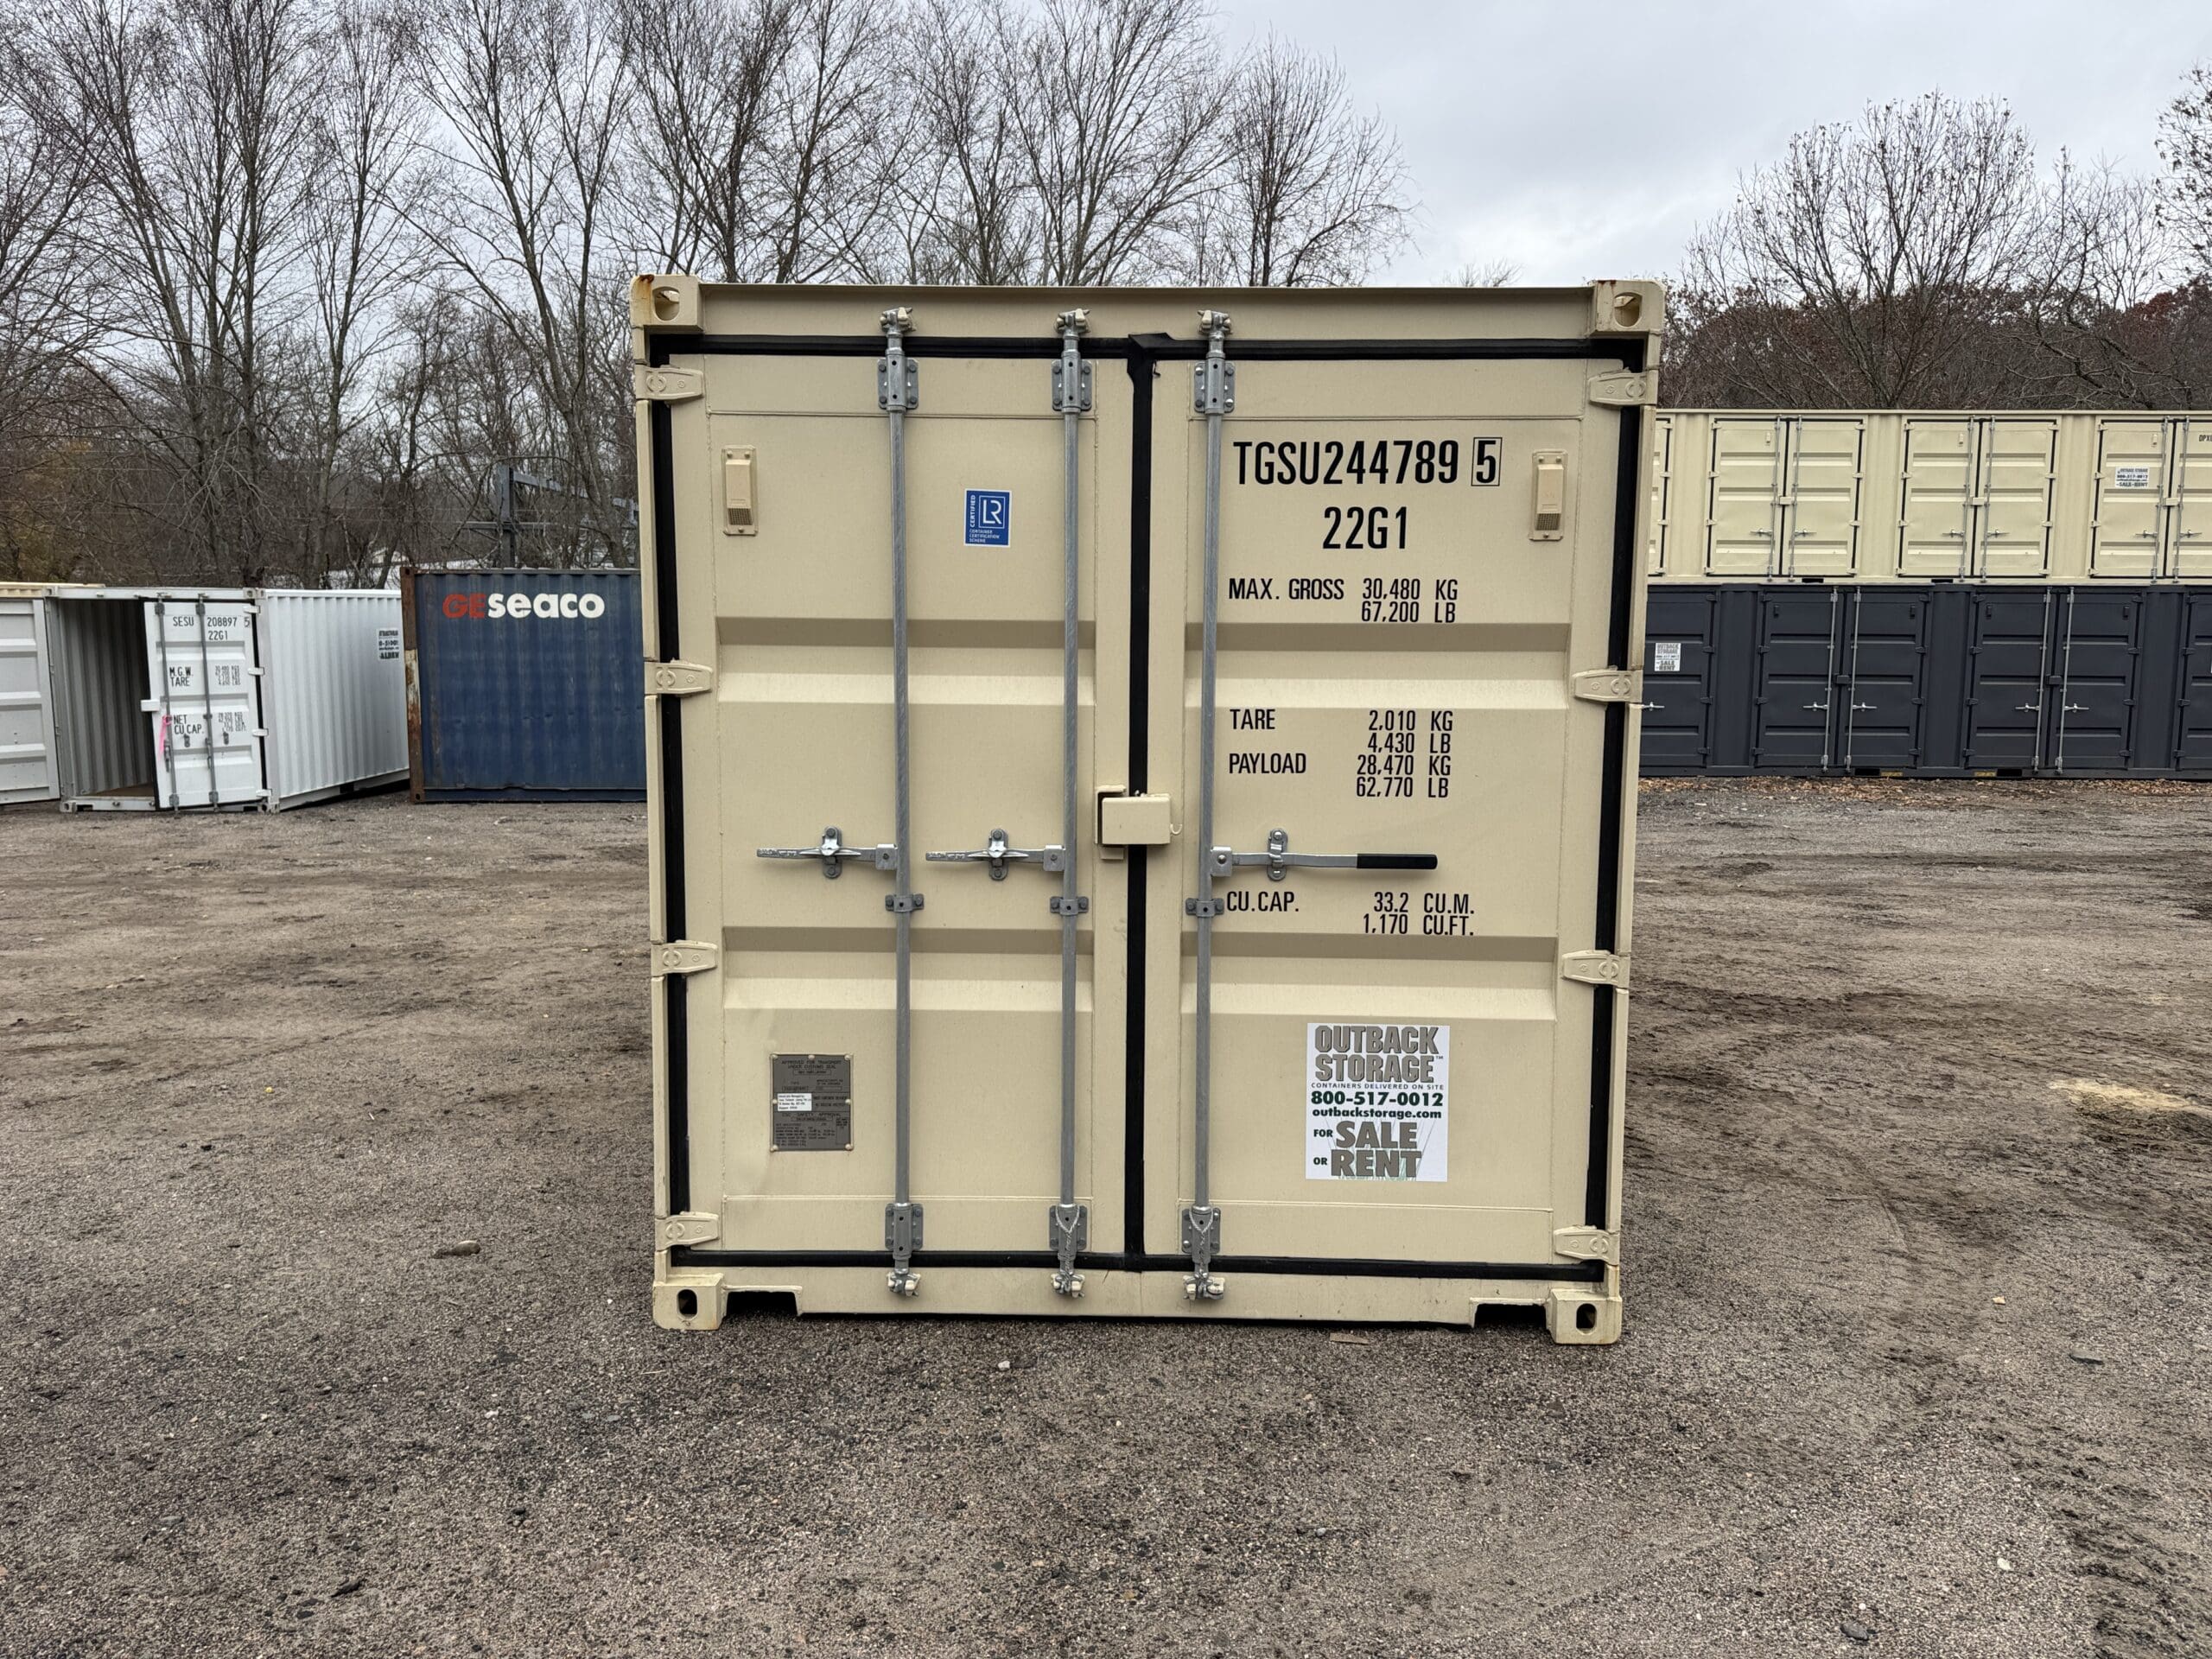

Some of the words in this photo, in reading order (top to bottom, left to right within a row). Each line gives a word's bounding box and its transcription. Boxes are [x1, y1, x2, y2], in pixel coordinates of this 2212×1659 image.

[1476, 440, 1497, 483] 5
[982, 499, 1002, 524] LR
[1322, 506, 1407, 550] 22G1
[1229, 578, 1280, 600] MAX.
[1288, 578, 1344, 601] GROSS
[1363, 578, 1421, 601] 30,480
[1435, 579, 1458, 601] KG
[173, 616, 194, 627] SESU
[207, 617, 238, 627] 208897
[1361, 601, 1420, 622] 67,200
[1434, 602, 1456, 623] LB
[208, 631, 228, 640] 22G1
[171, 677, 190, 687] TARE
[174, 715, 188, 724] NET
[1230, 709, 1275, 730] TARE
[1369, 710, 1416, 733] 2,010
[1431, 710, 1453, 732] KG
[1368, 733, 1414, 753] 4,430
[1430, 733, 1451, 753] LB
[1229, 753, 1306, 774] PAYLOAD
[1357, 754, 1414, 776] 28,470
[1429, 754, 1452, 776] KG
[1356, 776, 1414, 798] 62,770
[1428, 777, 1449, 798] LB
[1227, 891, 1300, 912] CU.CAP.
[1374, 892, 1409, 913] 33.2
[1363, 913, 1408, 934] 1,170
[1314, 1025, 1440, 1054] OUTBACK
[1315, 1054, 1434, 1083] STORAGE
[1311, 1090, 1444, 1106] 800-517-0012
[1313, 1107, 1442, 1120] outbackstorage.com
[1336, 1121, 1418, 1148] SALE
[1313, 1157, 1328, 1166] OR
[1331, 1149, 1422, 1178] RENT
